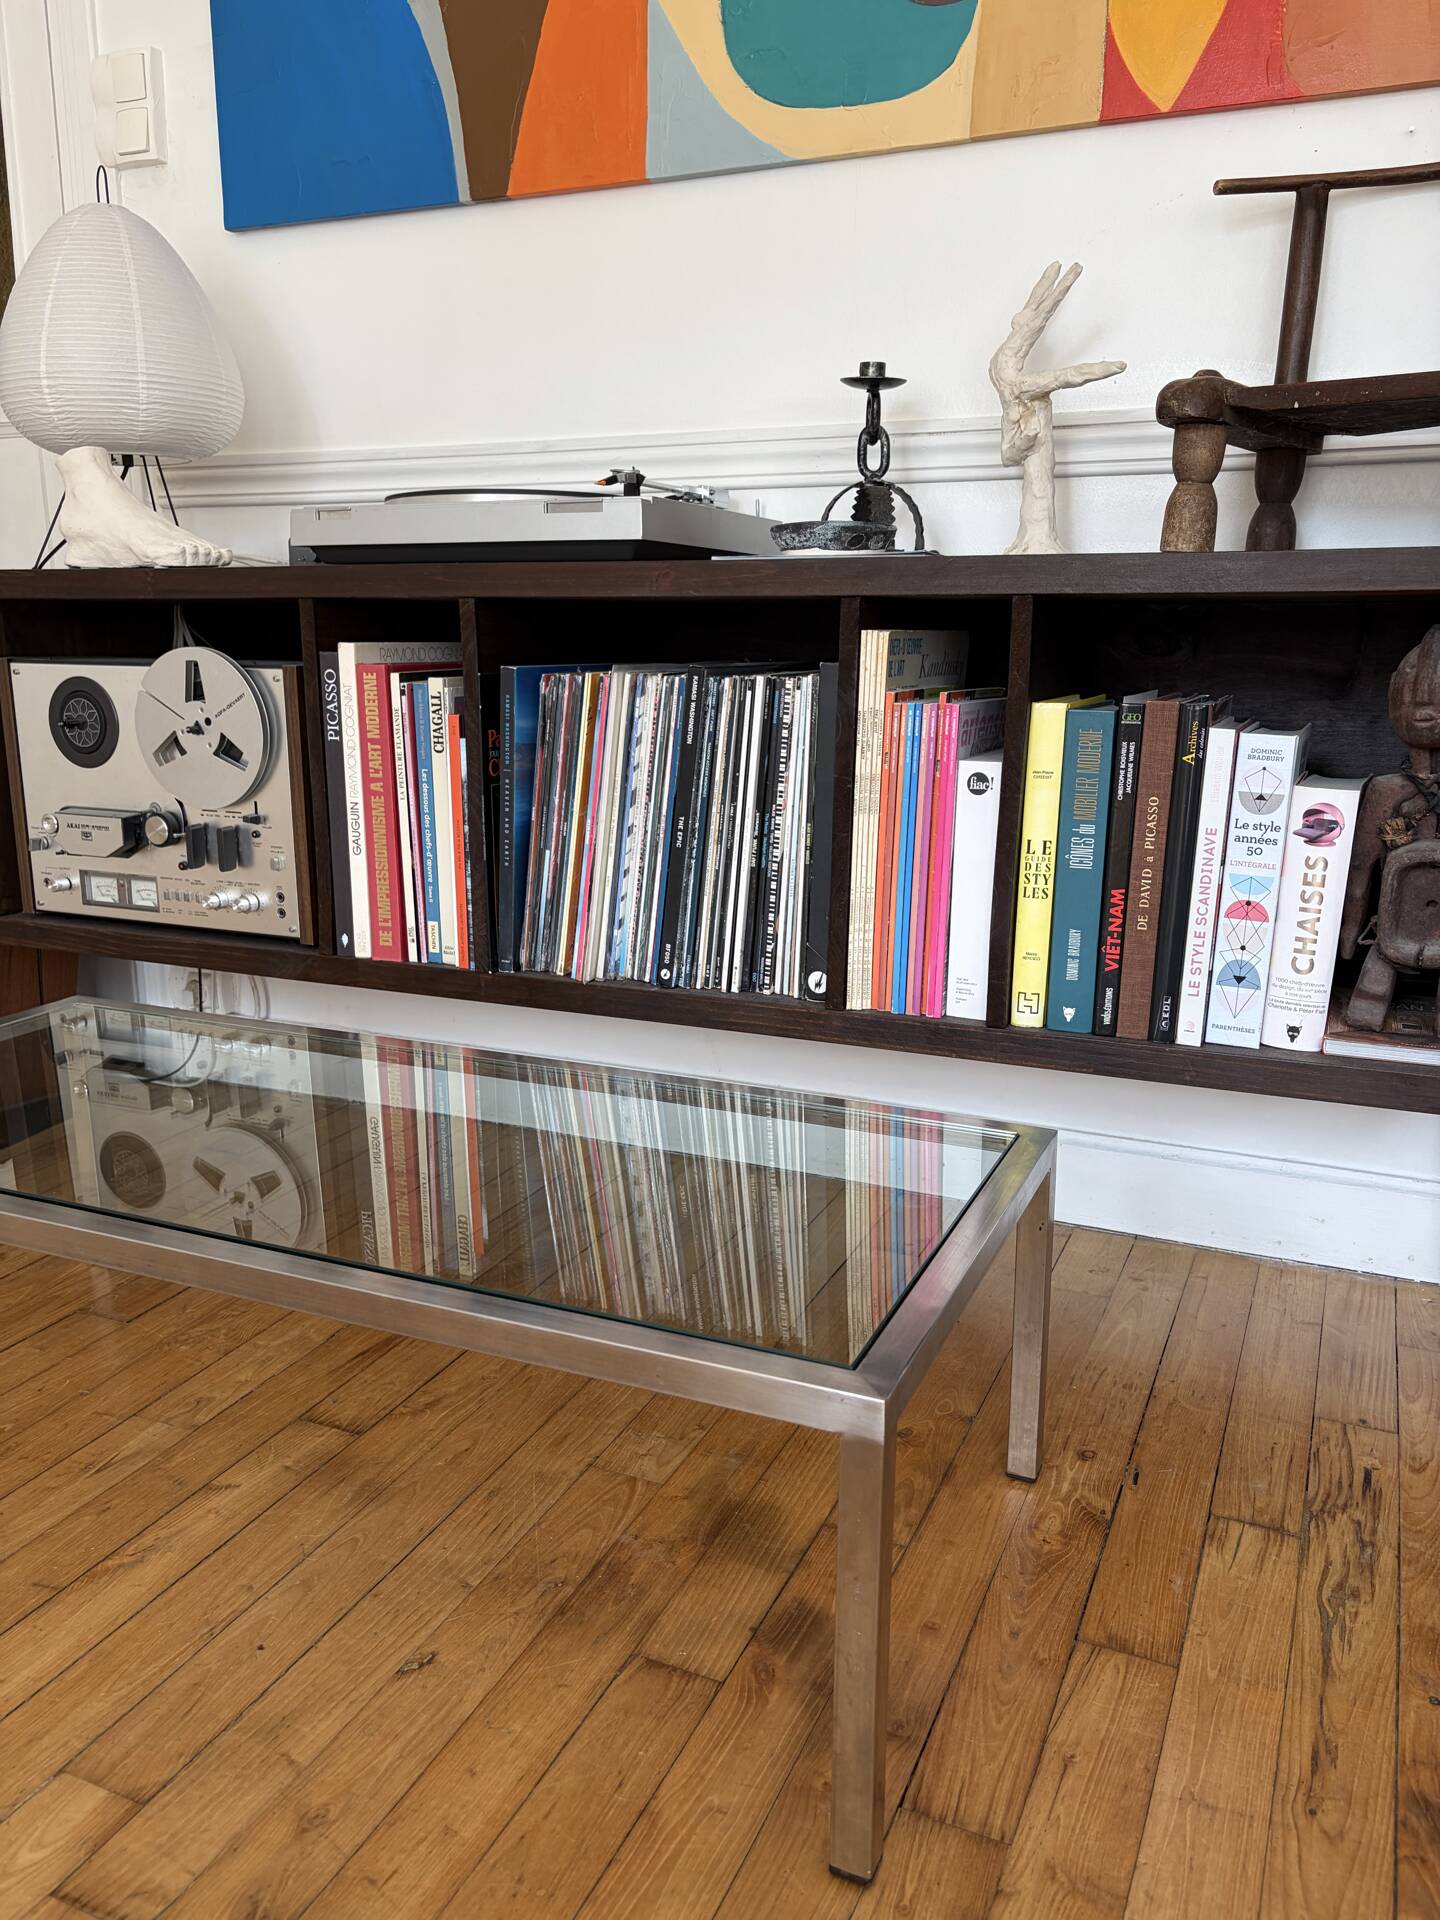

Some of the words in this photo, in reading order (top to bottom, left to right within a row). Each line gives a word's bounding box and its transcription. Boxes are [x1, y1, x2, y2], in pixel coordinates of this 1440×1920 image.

[324, 669, 340, 742] PICASSO
[343, 682, 355, 738] COGNIAT
[363, 672, 380, 738] MODERNE
[1122, 712, 1141, 721] GEO
[394, 707, 402, 749] FLAMANDE
[430, 691, 444, 754] CHAGALL
[686, 702, 696, 745] WASHINGTON
[1076, 728, 1104, 774] MODERNE
[1119, 741, 1128, 768] BOISVIEUX
[1128, 741, 1136, 762] WILMES
[1182, 720, 1199, 765] Archives
[346, 739, 360, 799] RAYMOND
[367, 743, 382, 777] L'ART
[1247, 754, 1285, 762] BRADBURY
[370, 782, 384, 792] A
[421, 769, 429, 782] Les
[969, 774, 994, 791] fiac!
[1117, 769, 1127, 800] CHRISTOPHE
[1126, 762, 1134, 794] JACQUELINE
[399, 791, 405, 800] LA
[422, 783, 431, 813] dessous
[1072, 778, 1100, 821] MOBILIER
[350, 801, 362, 856] GAUGUIN
[424, 814, 433, 828] des
[1072, 824, 1096, 834] du
[1144, 796, 1159, 849] PICASSO
[1234, 818, 1249, 829] Le
[1252, 819, 1282, 836] style
[1027, 839, 1052, 856] LE
[1234, 833, 1278, 846] années
[1246, 847, 1263, 856] 50
[371, 795, 392, 927] L'IMPRESSIONNISME
[424, 829, 434, 883] chefs-d'œuvre
[1024, 855, 1051, 863] GUIDE
[1065, 837, 1095, 870] ICÔNES
[1230, 858, 1277, 870] L'INTÉGRALE
[1023, 873, 1051, 886] STY
[1024, 862, 1051, 873] DES
[1196, 827, 1218, 926] SCANDINAVE
[1023, 887, 1049, 899] LES
[1139, 868, 1152, 908] DAVID
[1137, 915, 1148, 930] DE
[1291, 855, 1329, 976] CHAISES
[378, 931, 392, 946] DE
[1067, 928, 1081, 956] BRADBURY
[1100, 888, 1126, 972] VIÊT-NAM
[1191, 930, 1206, 976] STYLE
[1066, 958, 1079, 981] DOMINIC
[1188, 982, 1201, 998] LE
[1268, 1003, 1292, 1011] Charlotte
[1212, 1024, 1255, 1034] PARENTHÈSES
